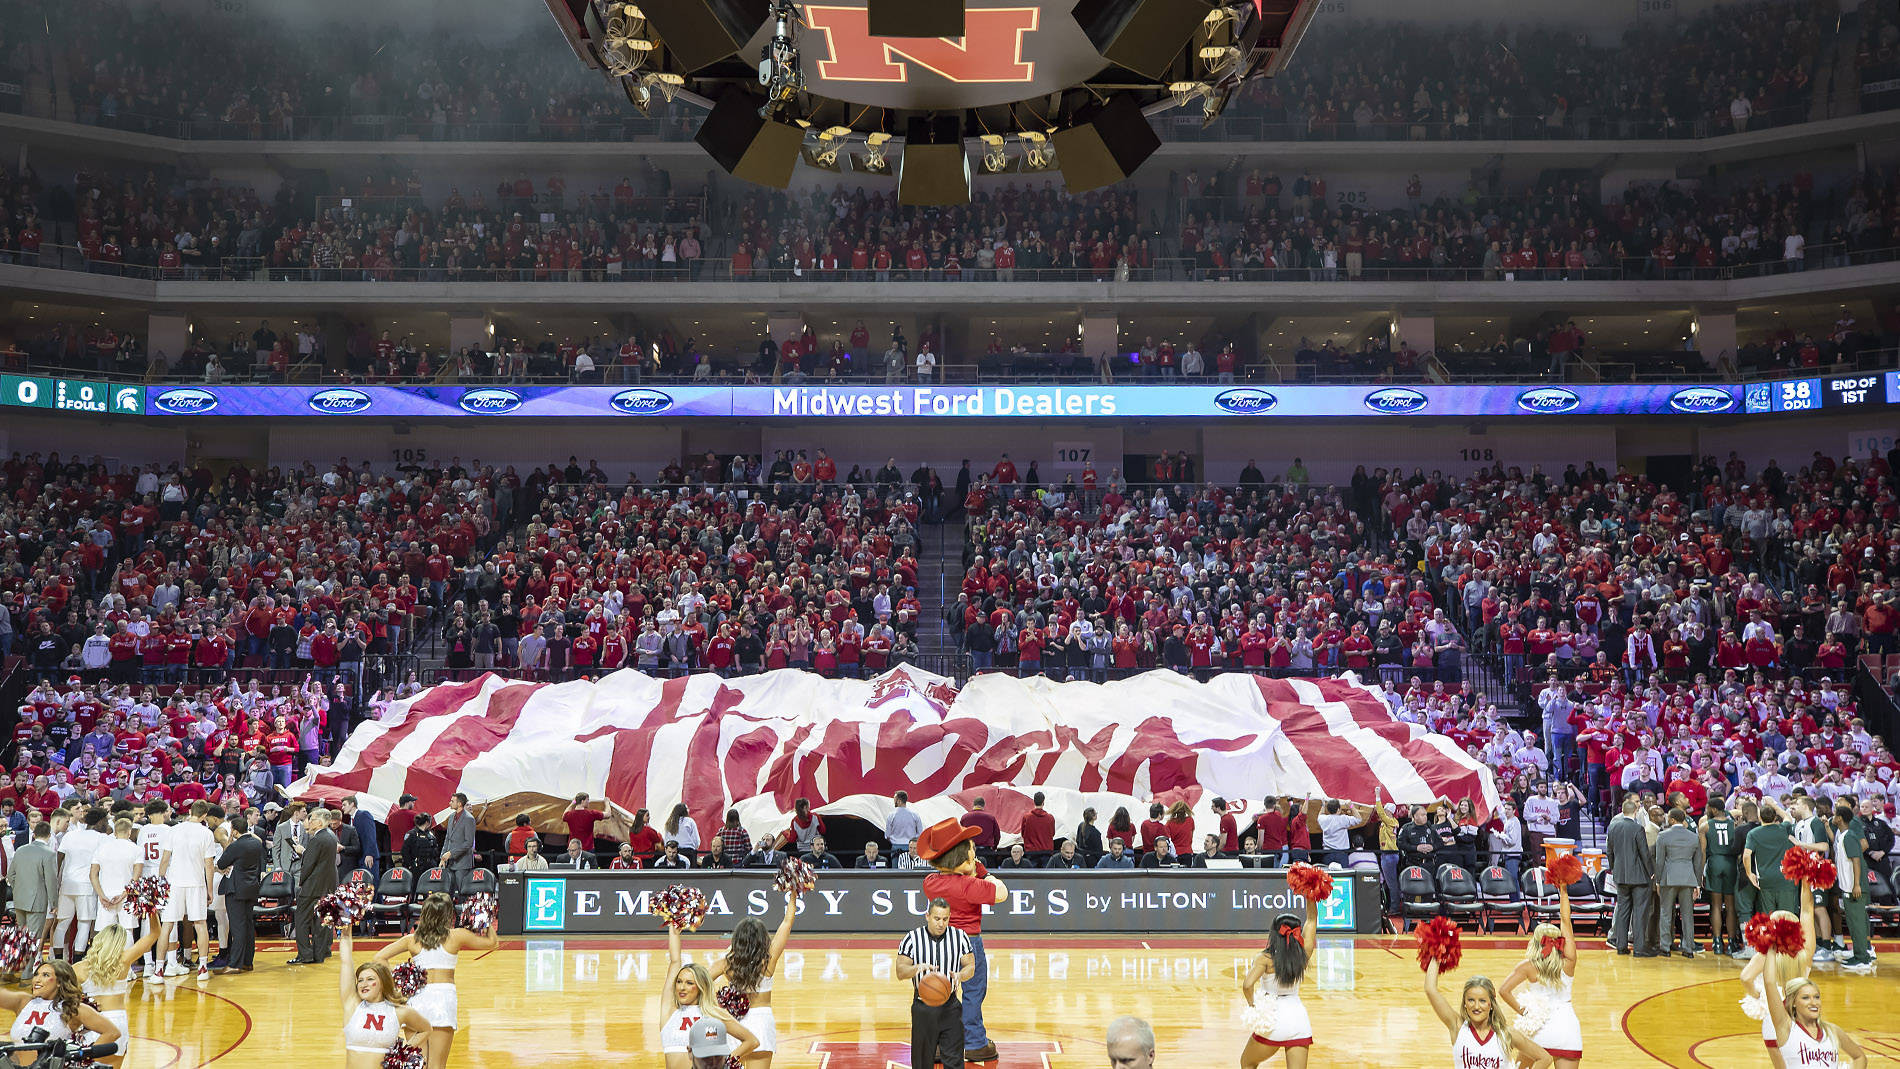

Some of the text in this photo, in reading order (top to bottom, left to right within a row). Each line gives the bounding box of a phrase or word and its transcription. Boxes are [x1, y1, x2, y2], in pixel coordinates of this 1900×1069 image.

[804, 5, 1040, 82] N
[1782, 382, 1810, 400] 38
[1831, 377, 1877, 391] END OF
[18, 381, 38, 403] 0
[80, 386, 93, 401] 0
[1841, 390, 1867, 404] 1ST
[66, 399, 106, 411] FOULS
[168, 394, 203, 408] Ford
[322, 394, 357, 408] Ford
[473, 394, 508, 408] Ford
[624, 394, 659, 408] Ford
[773, 388, 1116, 415] Midwest Ford Dealers
[1228, 393, 1262, 408] Ford
[1379, 393, 1413, 407] Ford
[1531, 392, 1565, 407] Ford
[1684, 392, 1718, 407] Ford
[1783, 399, 1811, 410] ODU
[393, 448, 426, 462] 105
[1058, 449, 1090, 462] 107
[1460, 448, 1494, 462] 108
[1716, 829, 1729, 846] 11
[144, 842, 159, 861] 15
[272, 872, 284, 883] N
[352, 870, 364, 882] N
[391, 869, 403, 880] N
[430, 869, 442, 880] N
[473, 869, 485, 881] N
[1410, 868, 1423, 879] N
[1451, 868, 1463, 880] N
[1491, 867, 1503, 879] N
[534, 886, 557, 921] E
[573, 889, 848, 916] EMASSY
[872, 889, 1070, 916] SUES
[1086, 893, 1111, 913] by
[1232, 889, 1305, 909] Lincoln
[24, 1011, 50, 1026] N
[363, 1013, 386, 1031] N
